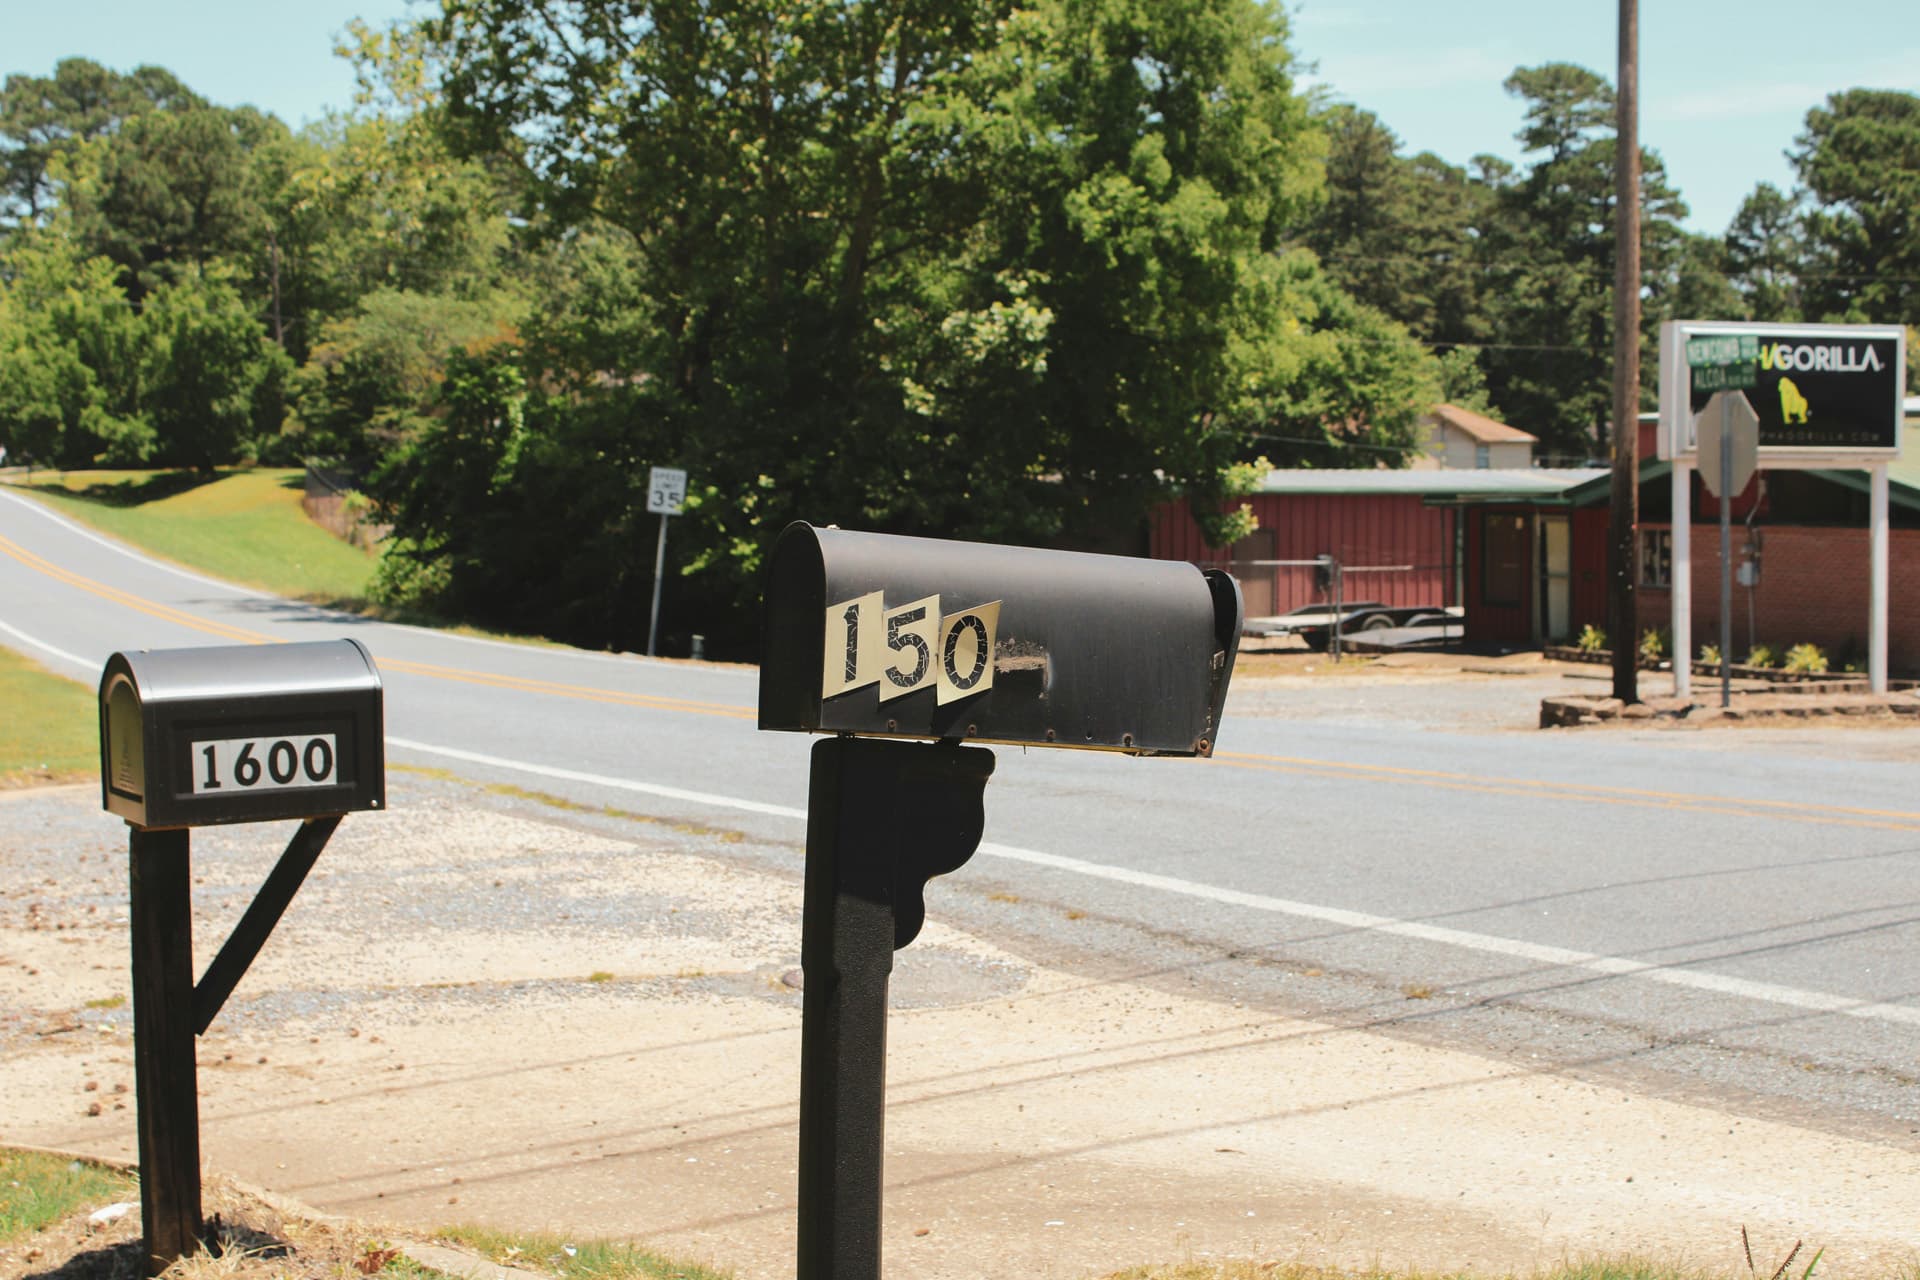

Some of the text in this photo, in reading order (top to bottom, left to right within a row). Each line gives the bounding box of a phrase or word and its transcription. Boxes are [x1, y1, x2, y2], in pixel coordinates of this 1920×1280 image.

[652, 490, 681, 508] 35
[843, 603, 991, 690] 150
[203, 738, 333, 788] 1600
